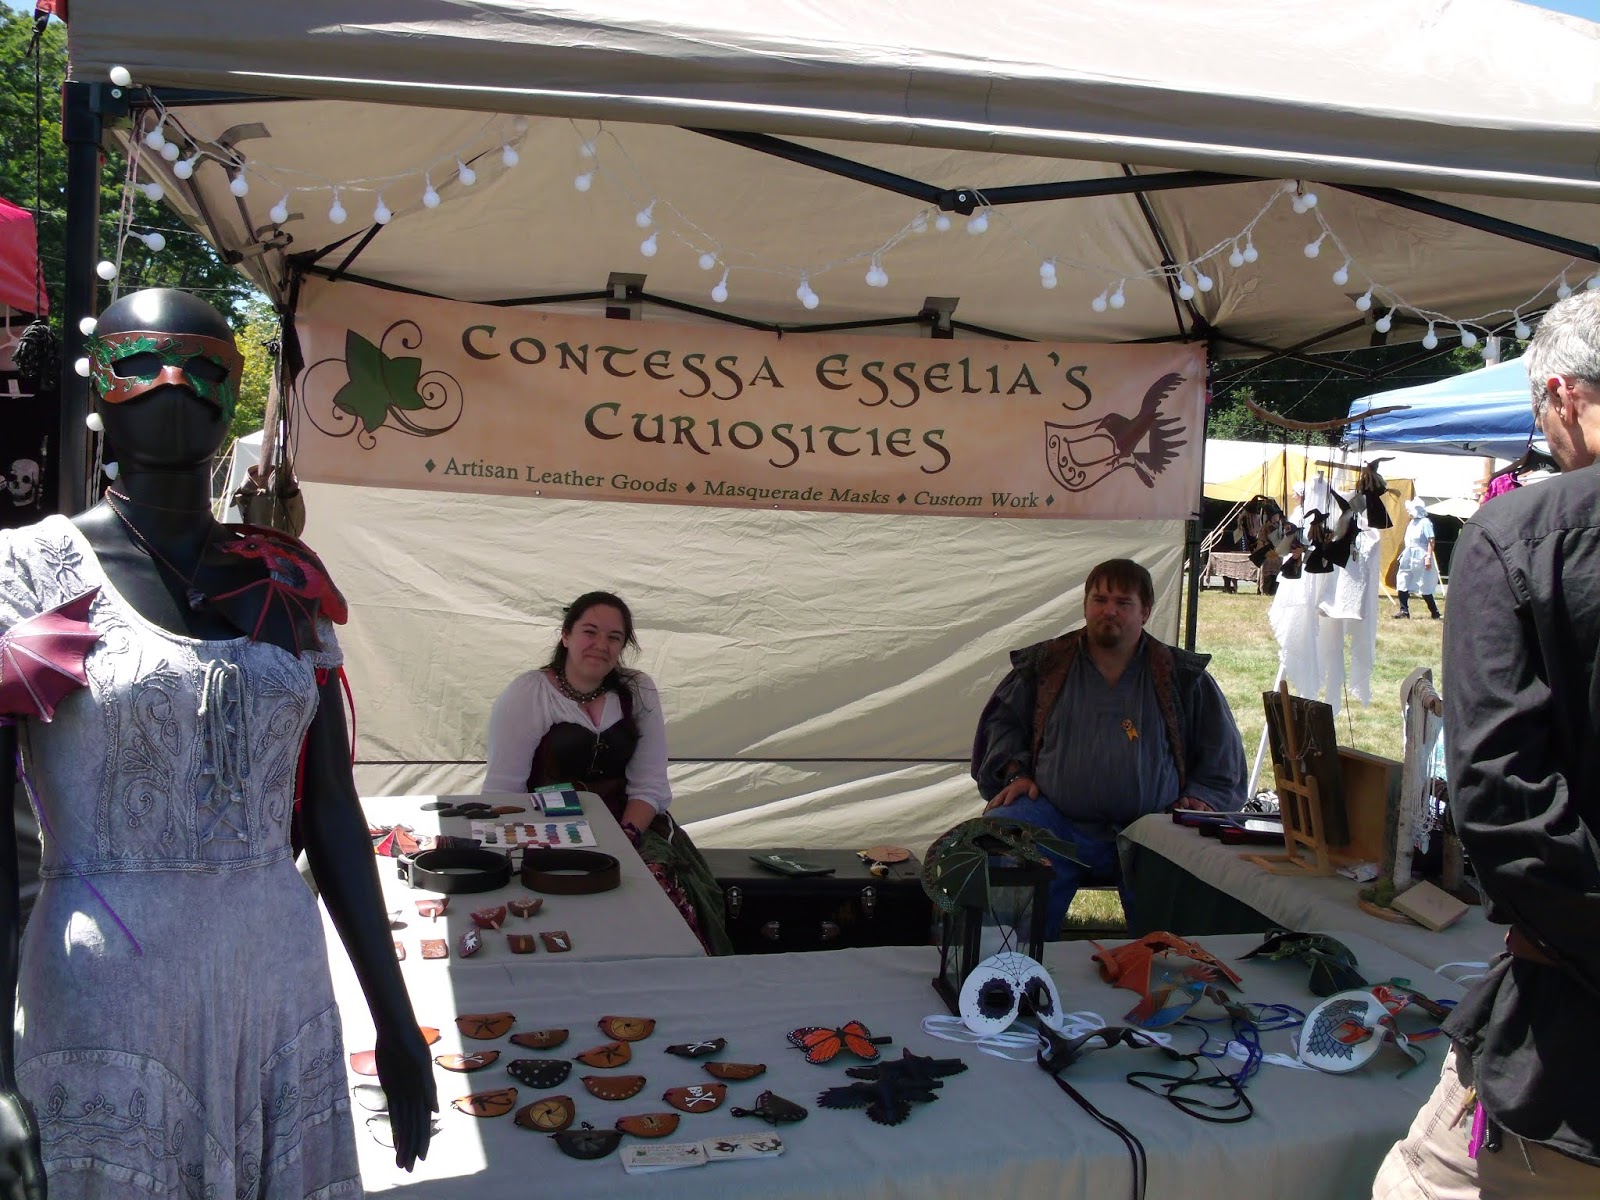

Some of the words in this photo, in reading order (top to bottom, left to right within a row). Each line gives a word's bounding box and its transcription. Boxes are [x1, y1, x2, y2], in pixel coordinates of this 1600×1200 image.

[444, 457, 518, 480] Artisan
[526, 466, 603, 488] Leather
[610, 474, 677, 494] Goods
[703, 480, 823, 502] Masquerade
[829, 488, 890, 504] Masks
[913, 491, 982, 507] Custom
[991, 492, 1039, 508] Work
